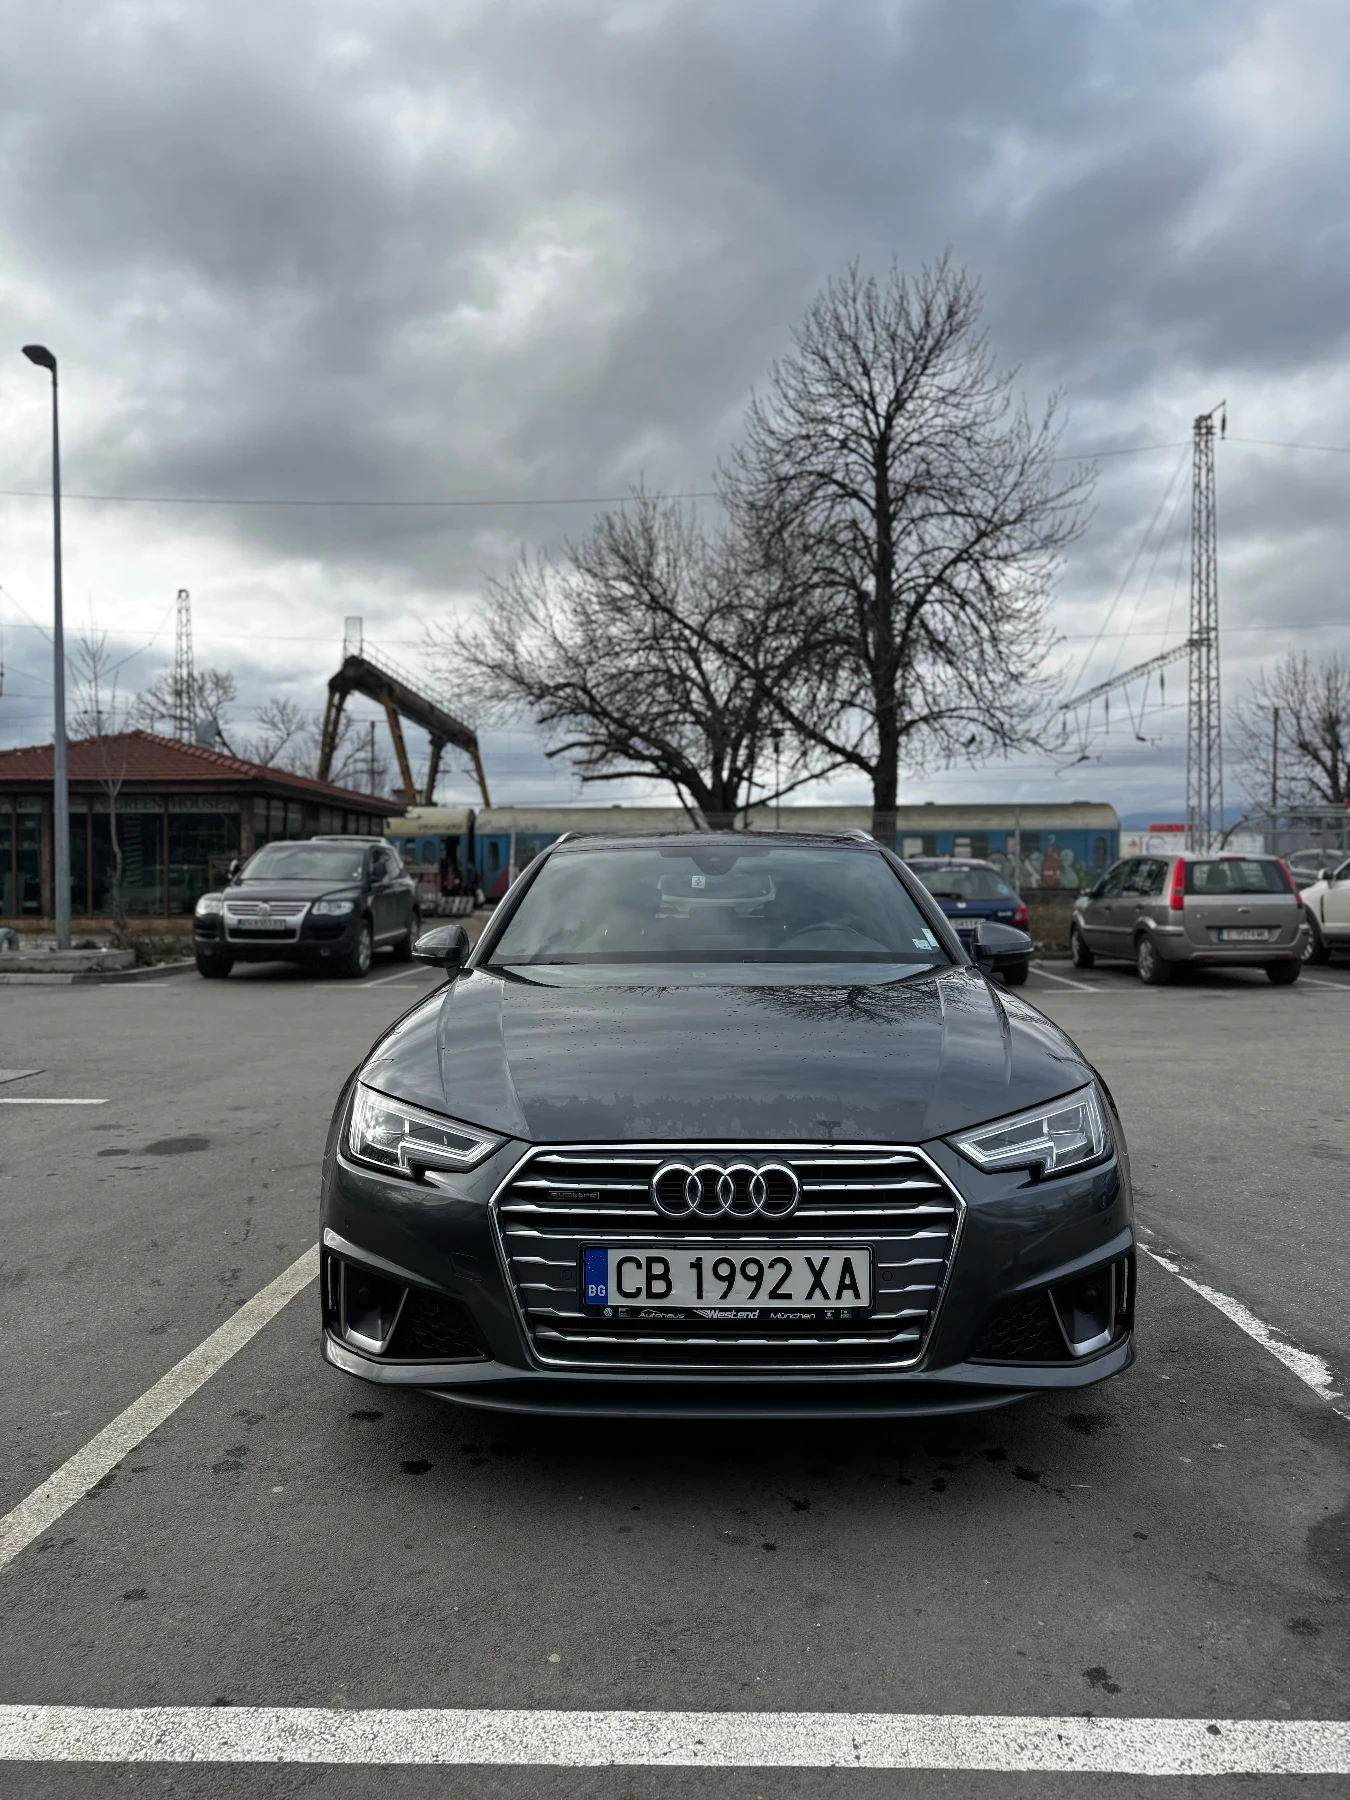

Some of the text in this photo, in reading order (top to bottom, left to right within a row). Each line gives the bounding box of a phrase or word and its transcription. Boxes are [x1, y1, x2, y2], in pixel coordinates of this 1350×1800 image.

[116, 799, 164, 810] GREEN
[616, 1255, 861, 1300] CB 1992 XA
[588, 1284, 606, 1297] BG
[638, 1311, 685, 1319] Autohaus
[707, 1309, 760, 1319] Westend
[769, 1311, 816, 1319] München
